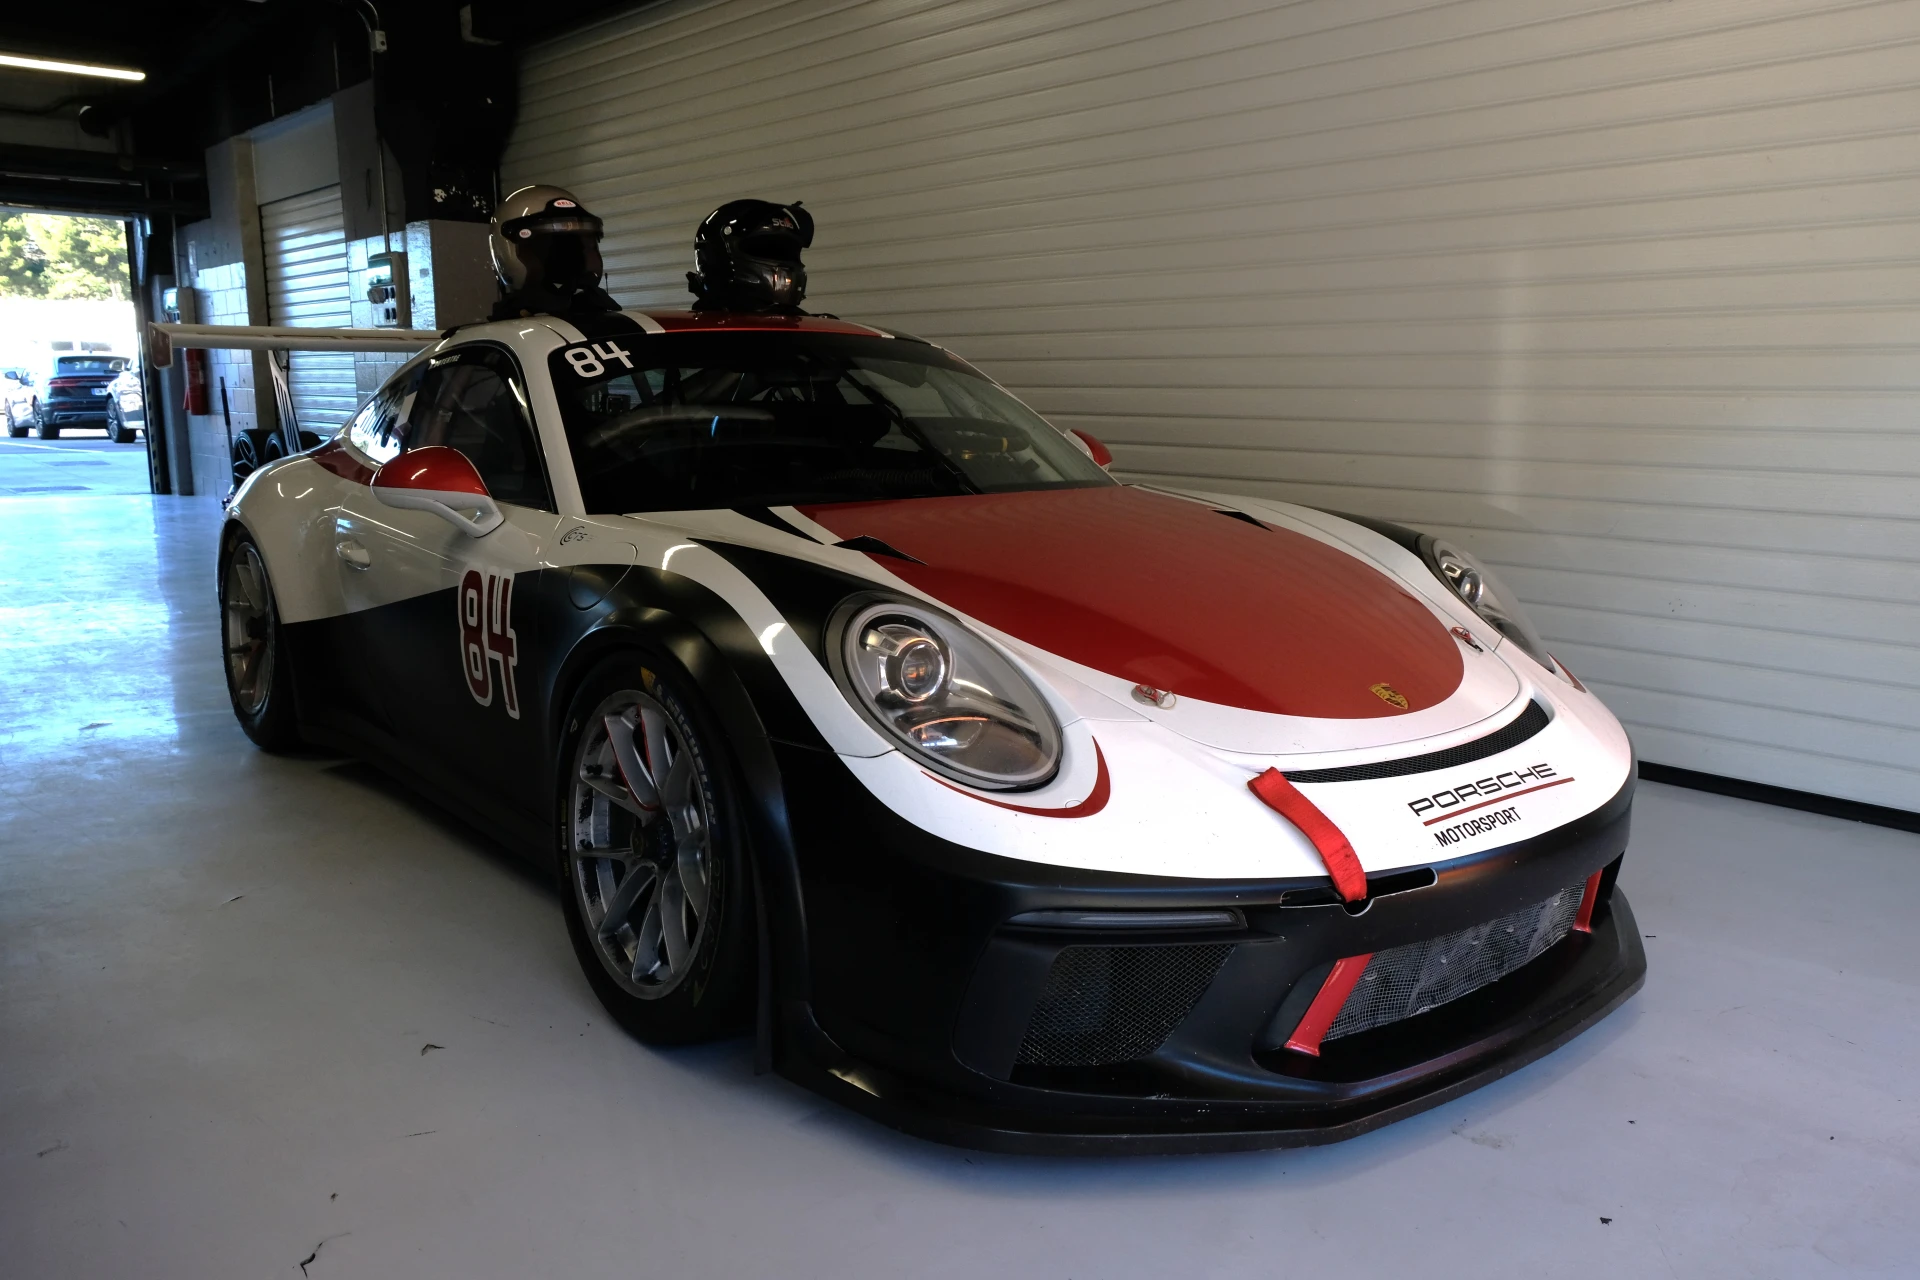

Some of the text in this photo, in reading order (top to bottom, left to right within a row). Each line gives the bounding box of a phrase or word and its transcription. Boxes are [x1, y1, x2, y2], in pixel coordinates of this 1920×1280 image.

[564, 341, 634, 378] 84
[460, 566, 519, 717] 84
[1407, 762, 1557, 817] PORSCHE
[1433, 806, 1522, 848] MOTORSPORT
